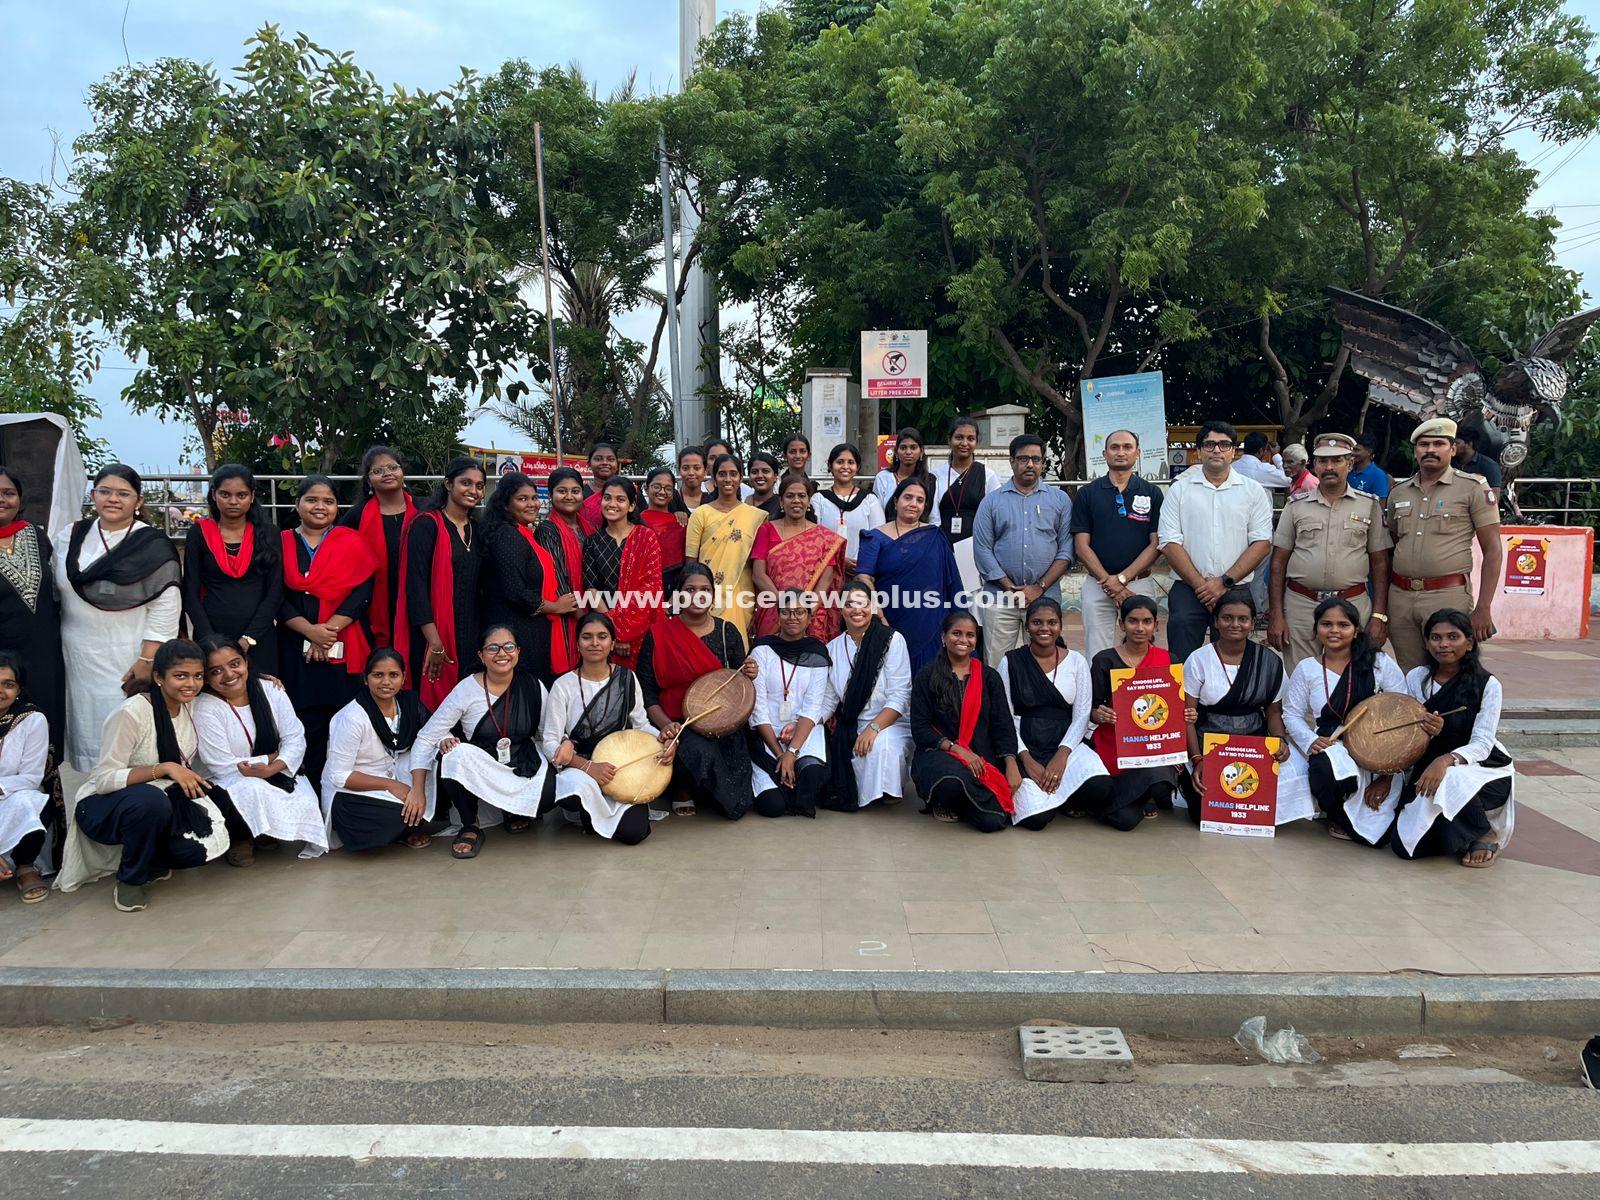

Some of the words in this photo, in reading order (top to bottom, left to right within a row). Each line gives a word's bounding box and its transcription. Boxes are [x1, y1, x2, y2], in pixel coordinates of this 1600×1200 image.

[1122, 735, 1149, 743] MANAS
[1149, 731, 1181, 741] HELPLINE
[1146, 742, 1162, 750] 1933
[1208, 800, 1235, 809] MANAS
[1235, 803, 1270, 812] HELPLINE
[1230, 811, 1247, 819] 1933
